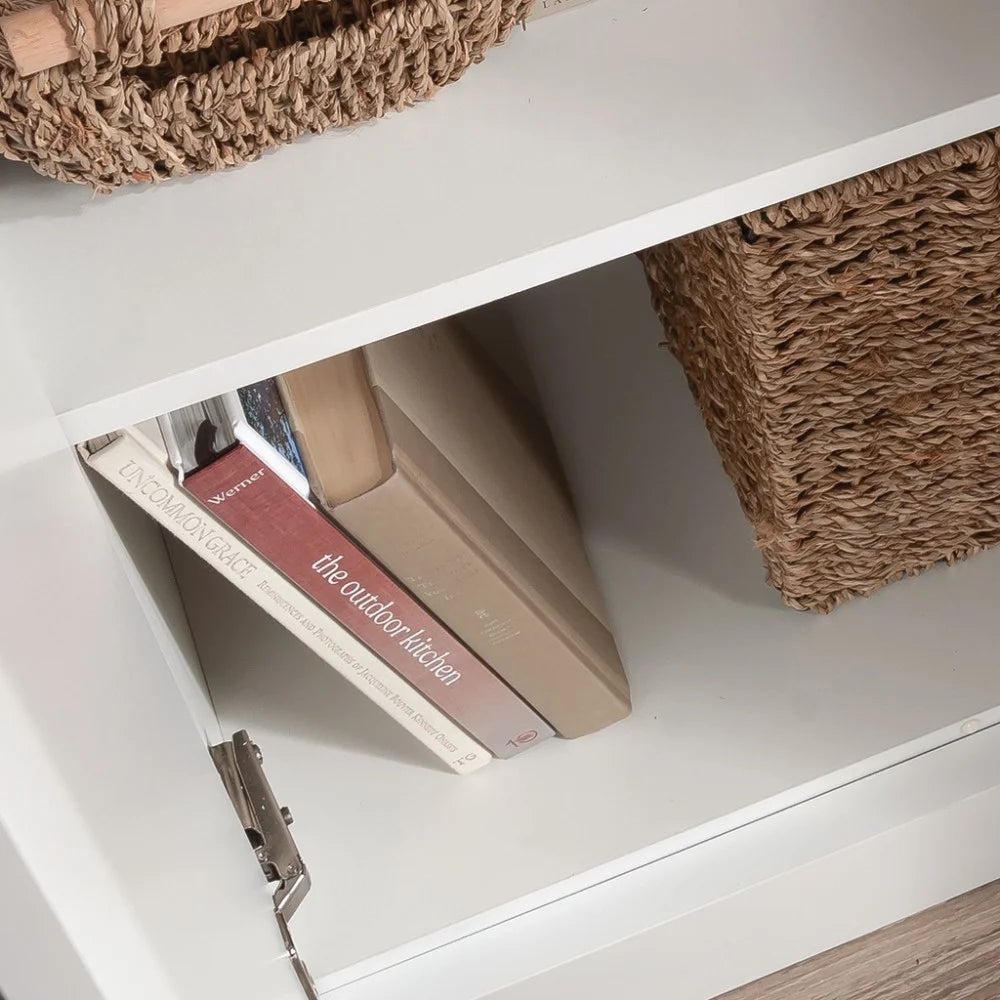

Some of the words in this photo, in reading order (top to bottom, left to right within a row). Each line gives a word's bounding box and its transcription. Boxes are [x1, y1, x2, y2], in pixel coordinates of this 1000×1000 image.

[118, 460, 216, 542] UNCOMMON
[204, 536, 258, 578] GRACE
[207, 468, 264, 504] Werner
[312, 554, 348, 584] the
[340, 575, 410, 637] outdoor
[399, 629, 461, 686] kitchen
